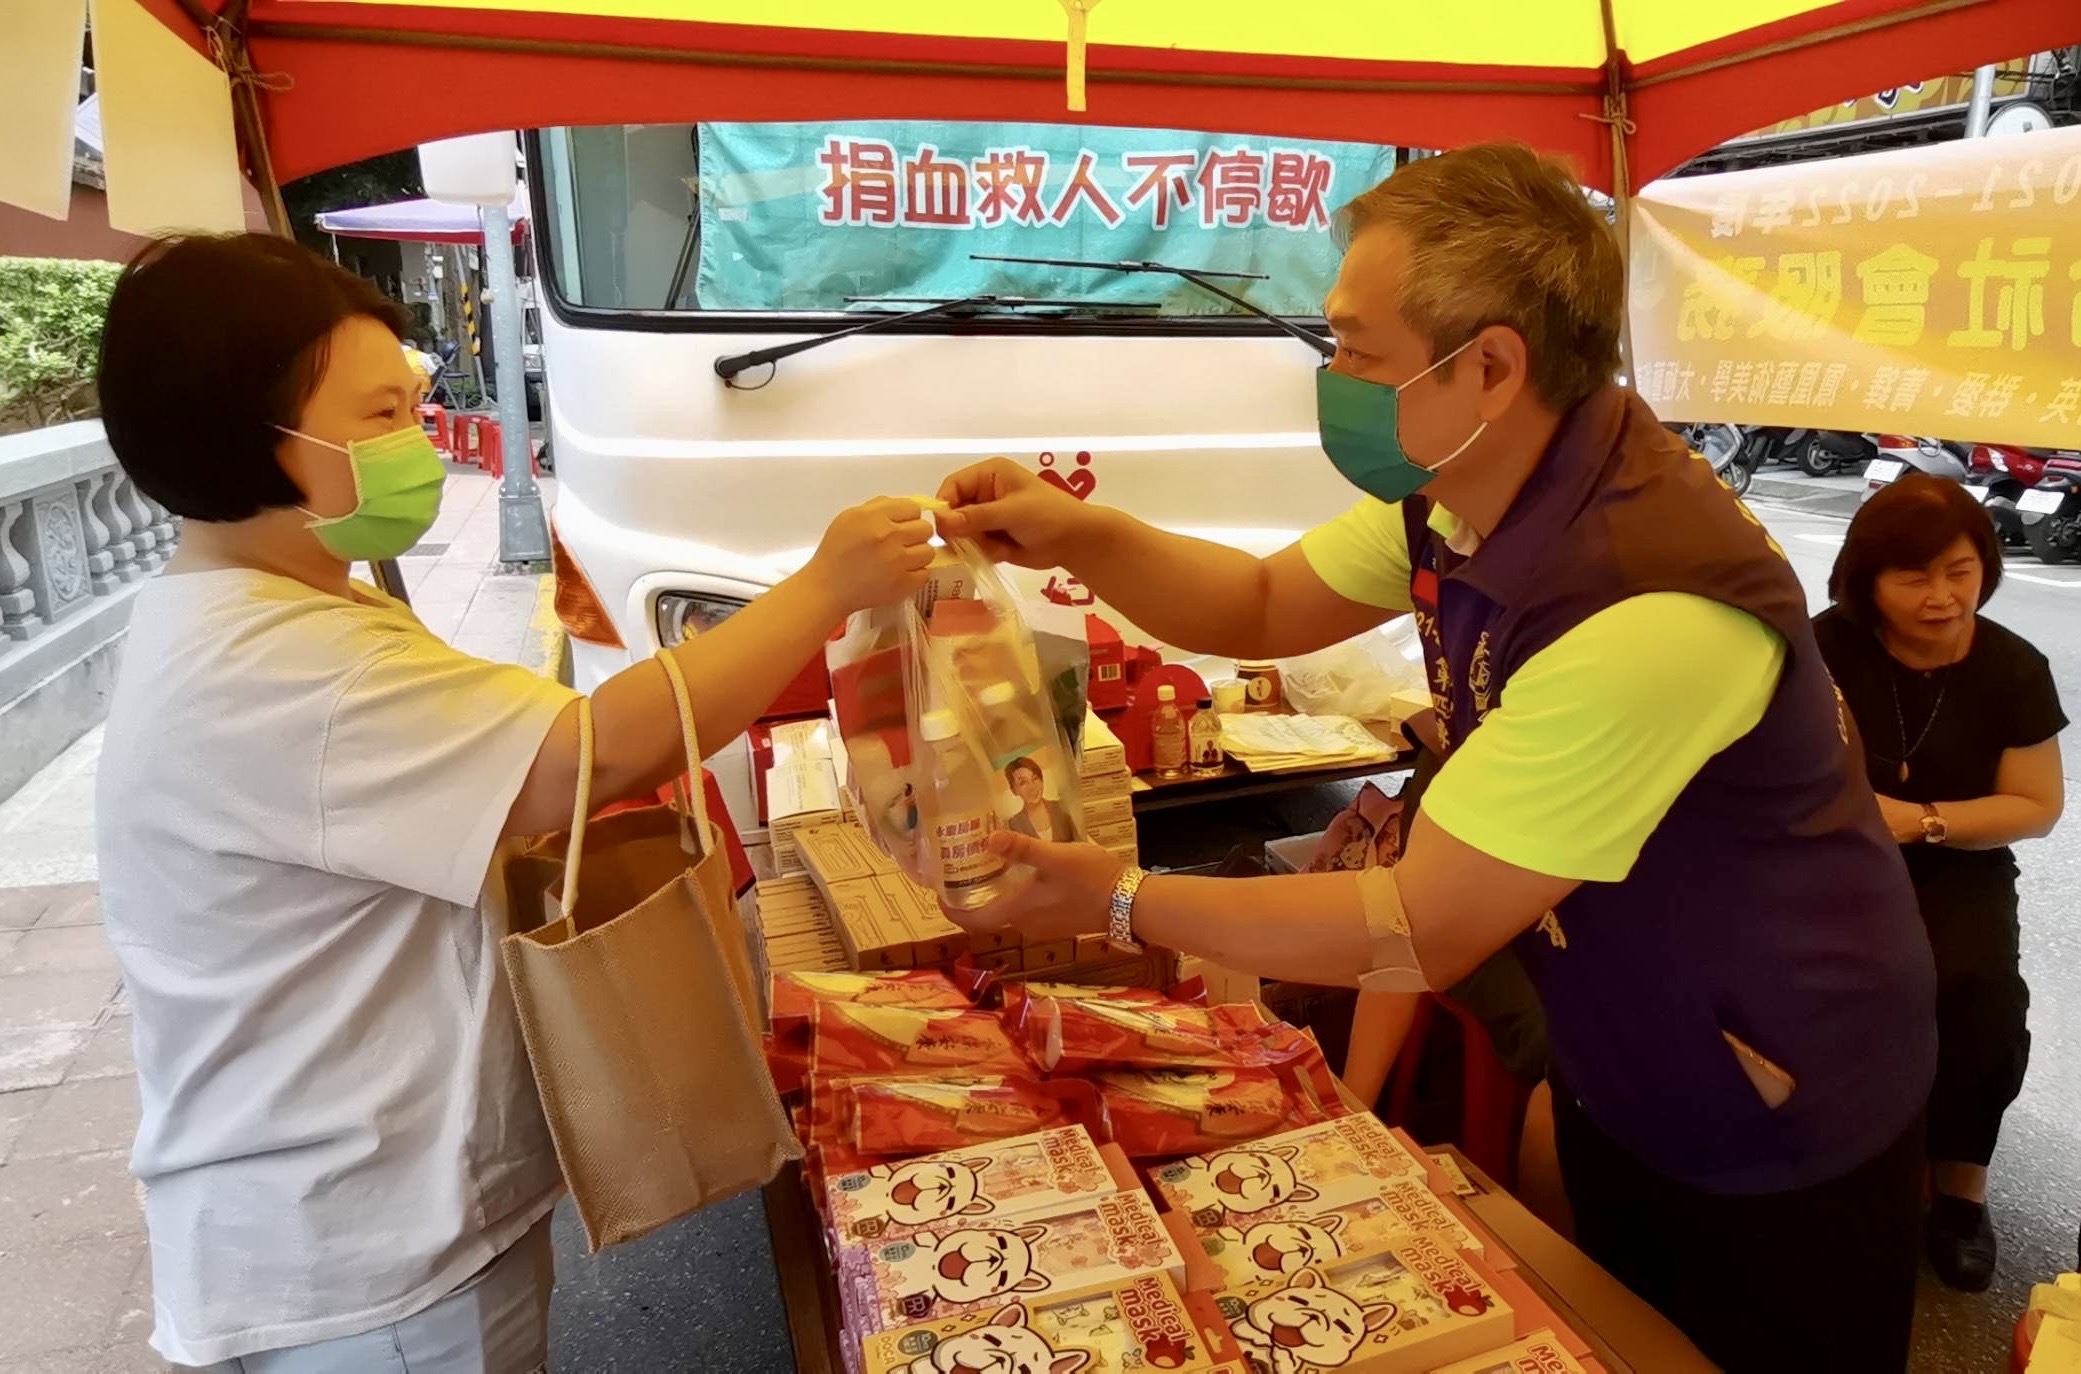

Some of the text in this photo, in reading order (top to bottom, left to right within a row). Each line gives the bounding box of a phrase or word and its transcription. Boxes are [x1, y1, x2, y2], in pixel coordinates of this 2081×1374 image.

[818, 135, 1334, 230] 捐血救人不停歇
[1045, 1135, 1075, 1178] mask
[1061, 1128, 1099, 1174] Medical
[1337, 1124, 1376, 1167] mask
[1350, 1116, 1401, 1161] Medical
[1102, 1201, 1136, 1246] mask
[1118, 1193, 1165, 1245] Medical
[1383, 1191, 1428, 1232] mask
[1398, 1181, 1452, 1229] Medical
[1403, 1248, 1452, 1293] mask
[1412, 1235, 1480, 1293] Medical
[1120, 1288, 1159, 1342] mask
[1137, 1276, 1193, 1341] Medical
